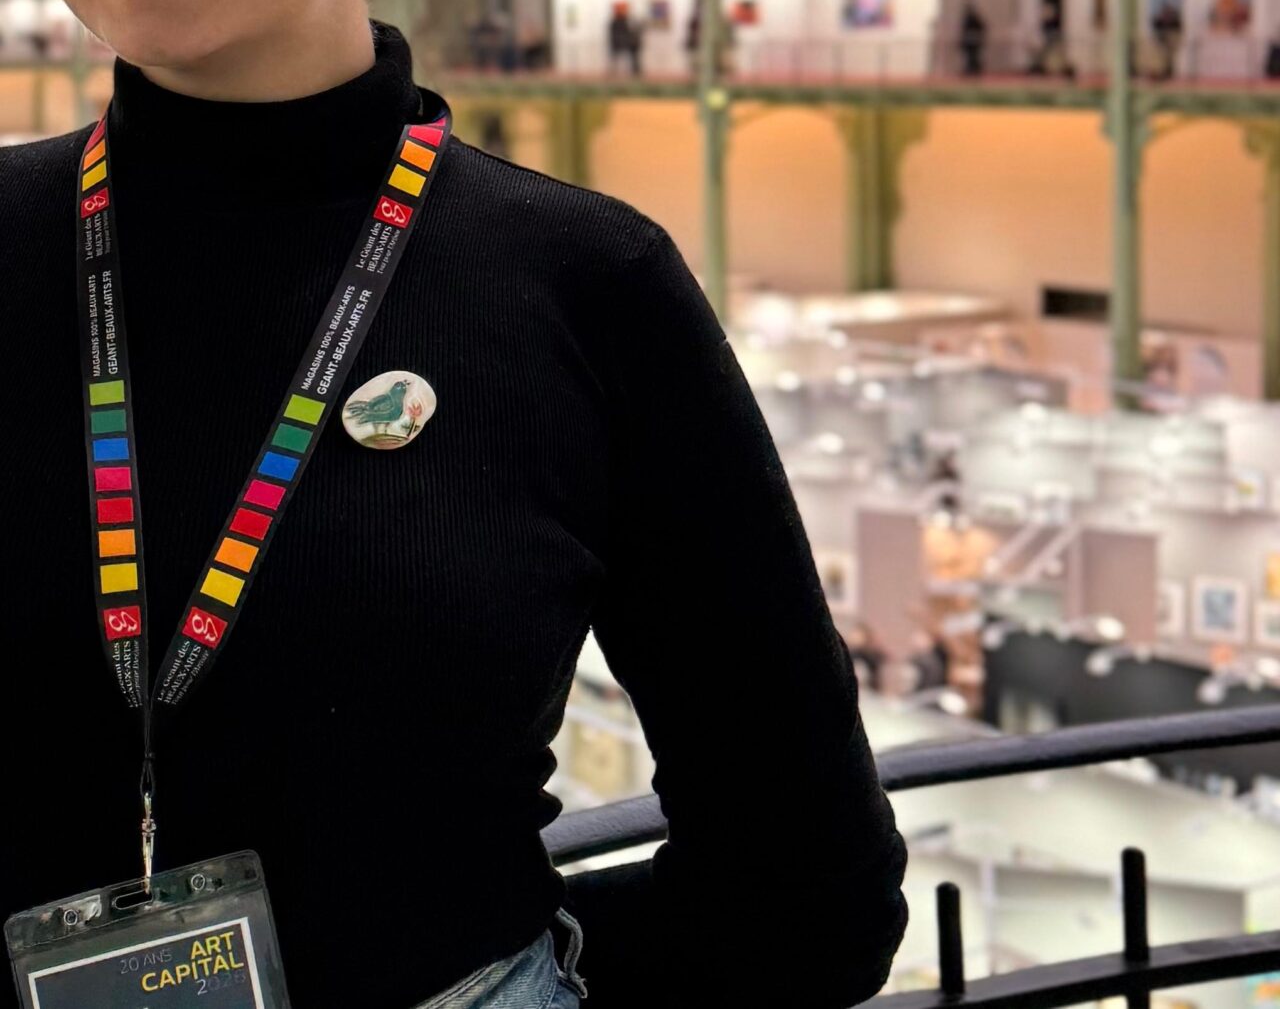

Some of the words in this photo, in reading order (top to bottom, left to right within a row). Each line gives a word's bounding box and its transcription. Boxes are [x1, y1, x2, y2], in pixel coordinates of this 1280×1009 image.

[367, 225, 392, 272] BEAUX-ARTS
[370, 222, 381, 236] des
[102, 270, 118, 375] GEANT-BEAUX-ARTS.FR
[301, 349, 326, 390] MAGASINS
[321, 330, 335, 349] 100%
[329, 285, 356, 330] BEAUX-ARTS
[317, 289, 373, 395] GEANT-BEAUX-ARTS.FR
[91, 337, 101, 377] MAGASINS
[178, 640, 190, 658] des
[120, 956, 139, 974] 20
[143, 948, 173, 966] ANS
[191, 931, 234, 959] ART
[142, 951, 244, 991] CAPITAL
